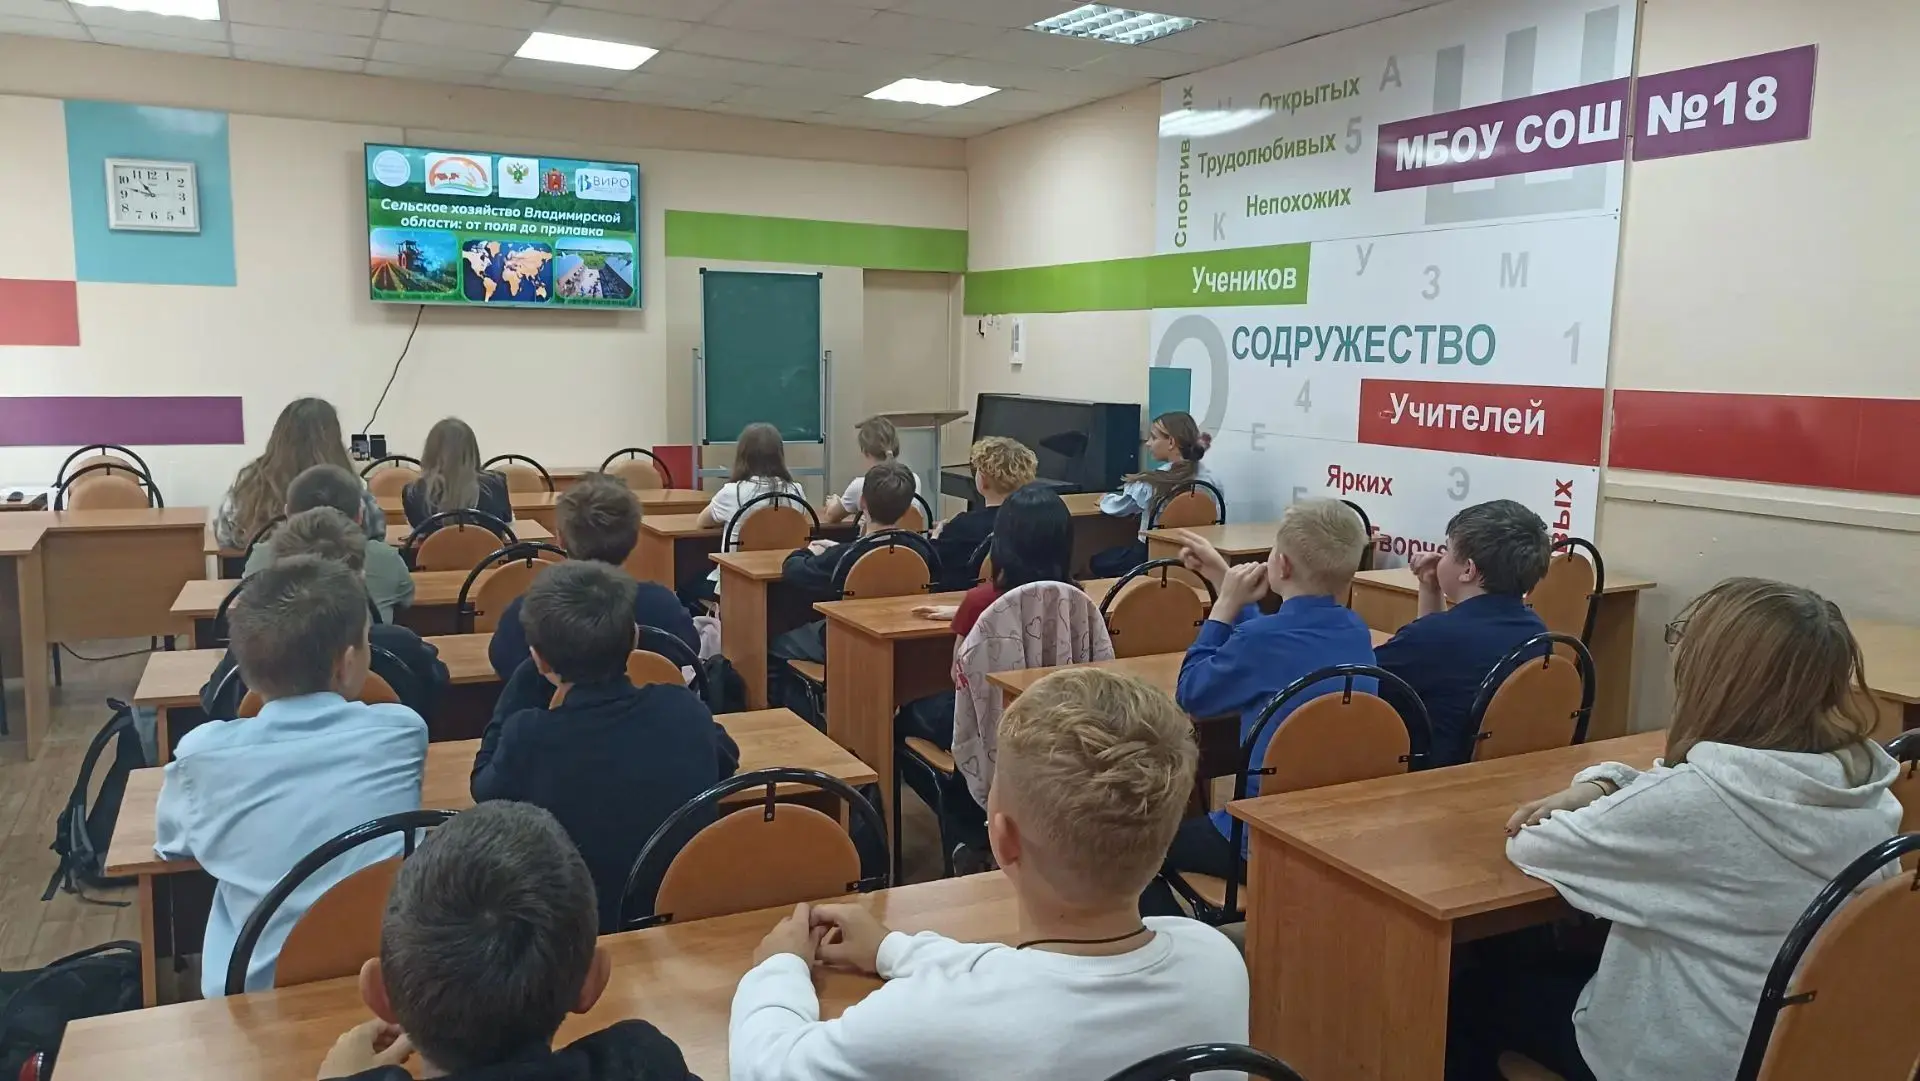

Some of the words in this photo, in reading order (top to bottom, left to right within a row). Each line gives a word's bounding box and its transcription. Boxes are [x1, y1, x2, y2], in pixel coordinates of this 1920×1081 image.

[1259, 77, 1360, 115] Открытых
[1345, 116, 1363, 154] 5
[1395, 121, 1503, 172] МБОУ
[1515, 99, 1622, 153] СОШ
[1647, 76, 1778, 136] №18
[1174, 85, 1194, 248] Спортивх
[1198, 133, 1336, 178] Трудолюбивых
[119, 175, 129, 184] 10
[133, 170, 141, 179] 11
[147, 171, 158, 180] 12
[166, 172, 169, 181] 1
[177, 179, 184, 188] 2
[593, 176, 629, 188] ВИРО
[120, 190, 128, 199] 9
[179, 193, 186, 201] 3
[1246, 187, 1351, 218] Непохожих
[121, 203, 130, 213] 8
[135, 210, 143, 220] 7
[150, 211, 158, 220] 6
[166, 211, 174, 221] 5
[381, 198, 448, 214] Сельское
[451, 204, 521, 218] хозяйство
[524, 207, 620, 224] Владимирской
[400, 215, 462, 229] области:
[466, 220, 482, 230] от
[484, 221, 517, 233] поля
[520, 223, 537, 234] до
[540, 225, 604, 237] прилавка
[1192, 266, 1297, 294] Учеников
[1231, 324, 1496, 367] СОДРУЖЕСТВО
[1563, 321, 1582, 365] 1
[1294, 378, 1312, 413] 4
[1389, 392, 1546, 436] Учителей
[1326, 464, 1393, 496] Ярких
